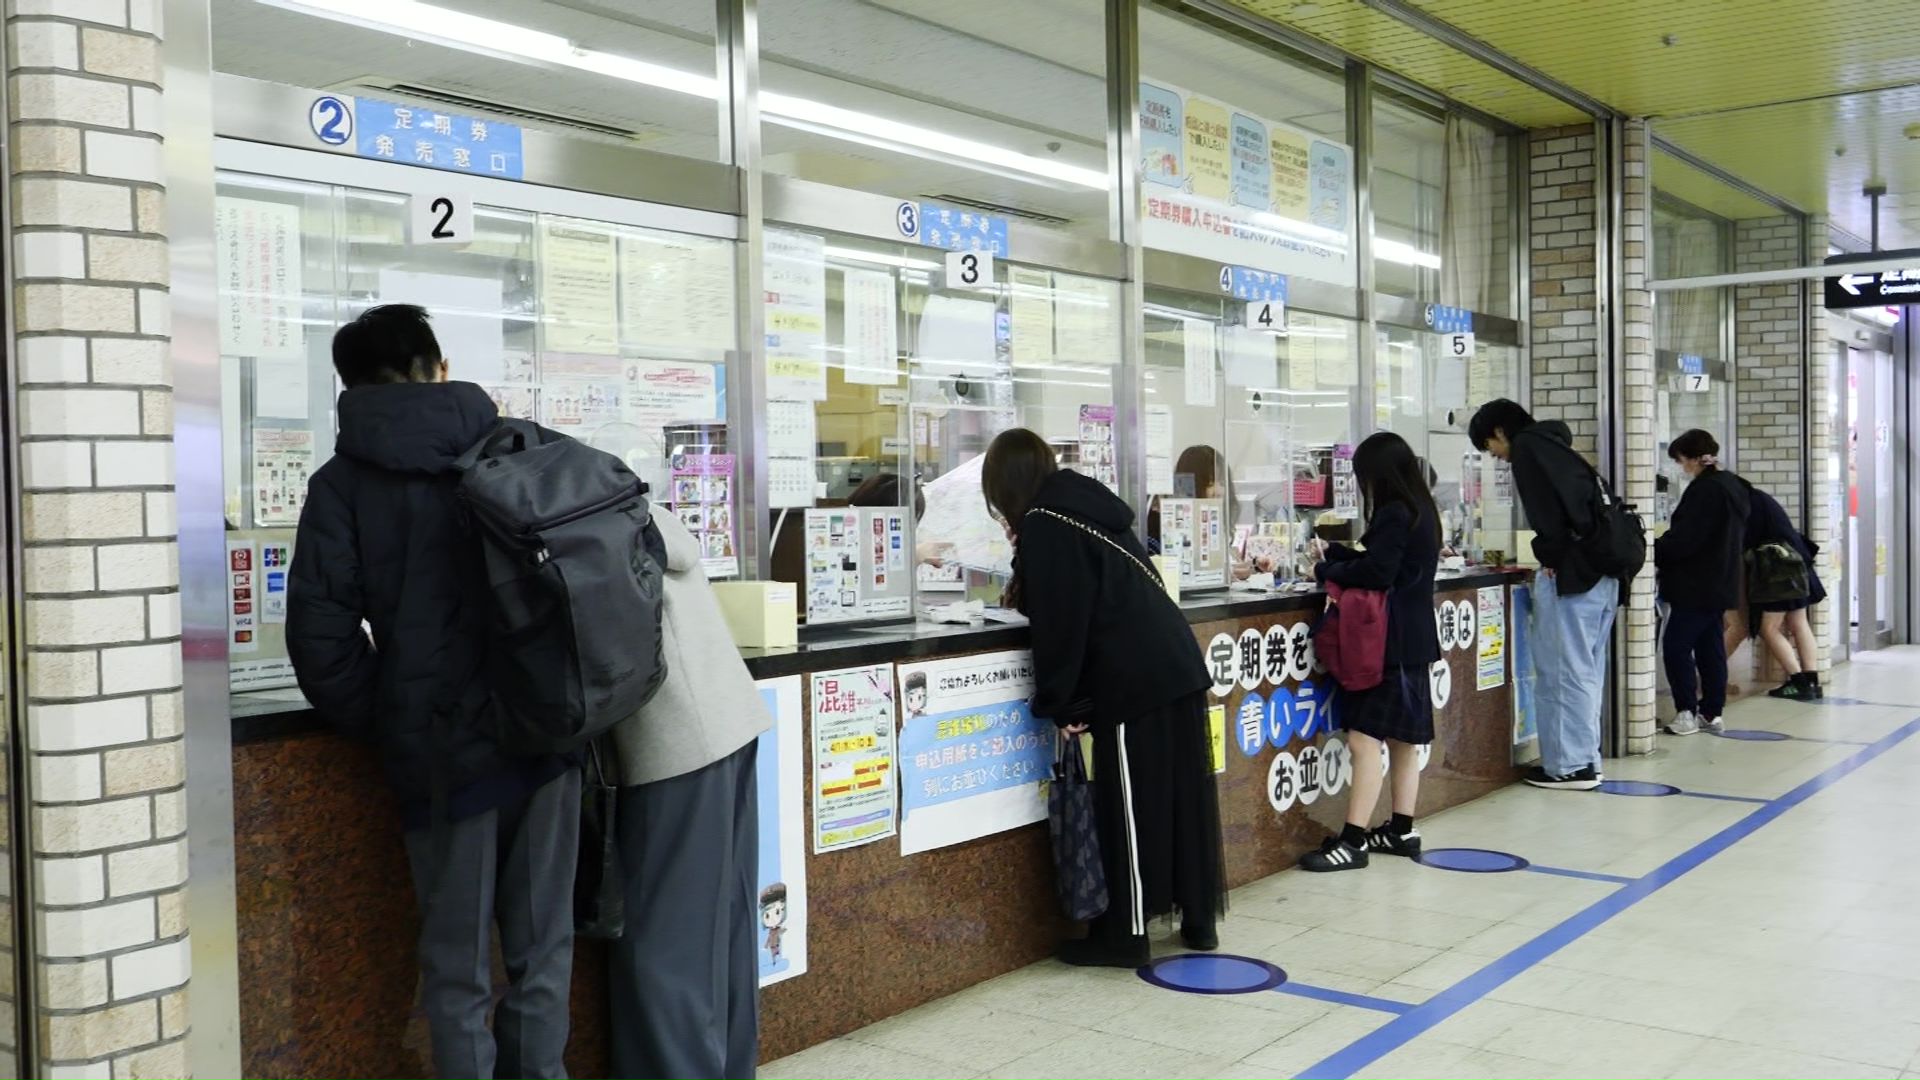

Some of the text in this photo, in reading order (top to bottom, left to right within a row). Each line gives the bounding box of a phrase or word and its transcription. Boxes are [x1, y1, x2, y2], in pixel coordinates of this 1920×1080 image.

[394, 108, 488, 142] 定期券
[375, 134, 506, 173] 発売窓口
[430, 197, 455, 239] 2
[961, 254, 979, 284] 3
[1258, 303, 1273, 327] 4
[1453, 336, 1466, 355] 5
[1692, 376, 1702, 390] 7
